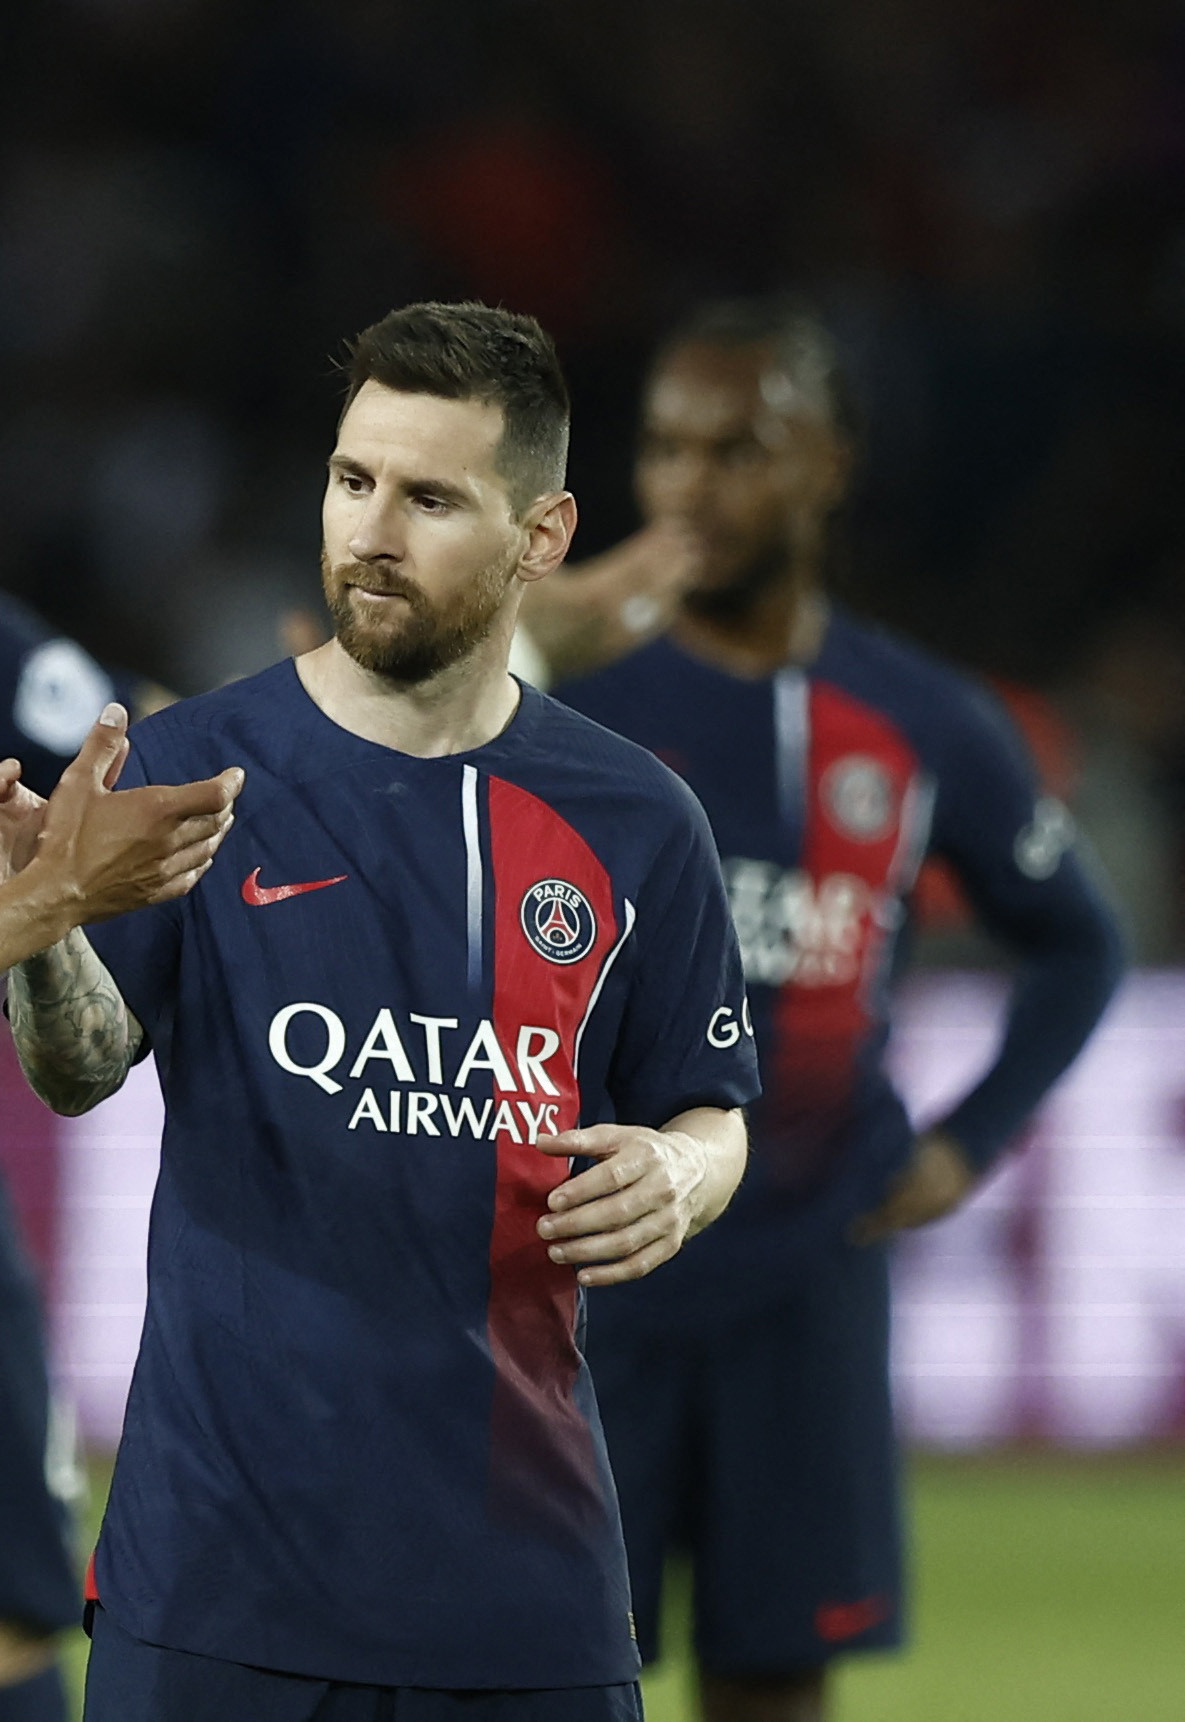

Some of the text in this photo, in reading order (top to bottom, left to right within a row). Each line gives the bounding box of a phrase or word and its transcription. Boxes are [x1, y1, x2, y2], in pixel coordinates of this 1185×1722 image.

[533, 885, 582, 908] PARIS
[269, 1002, 560, 1096] QATAR
[348, 1087, 560, 1145] AIRWAYS
